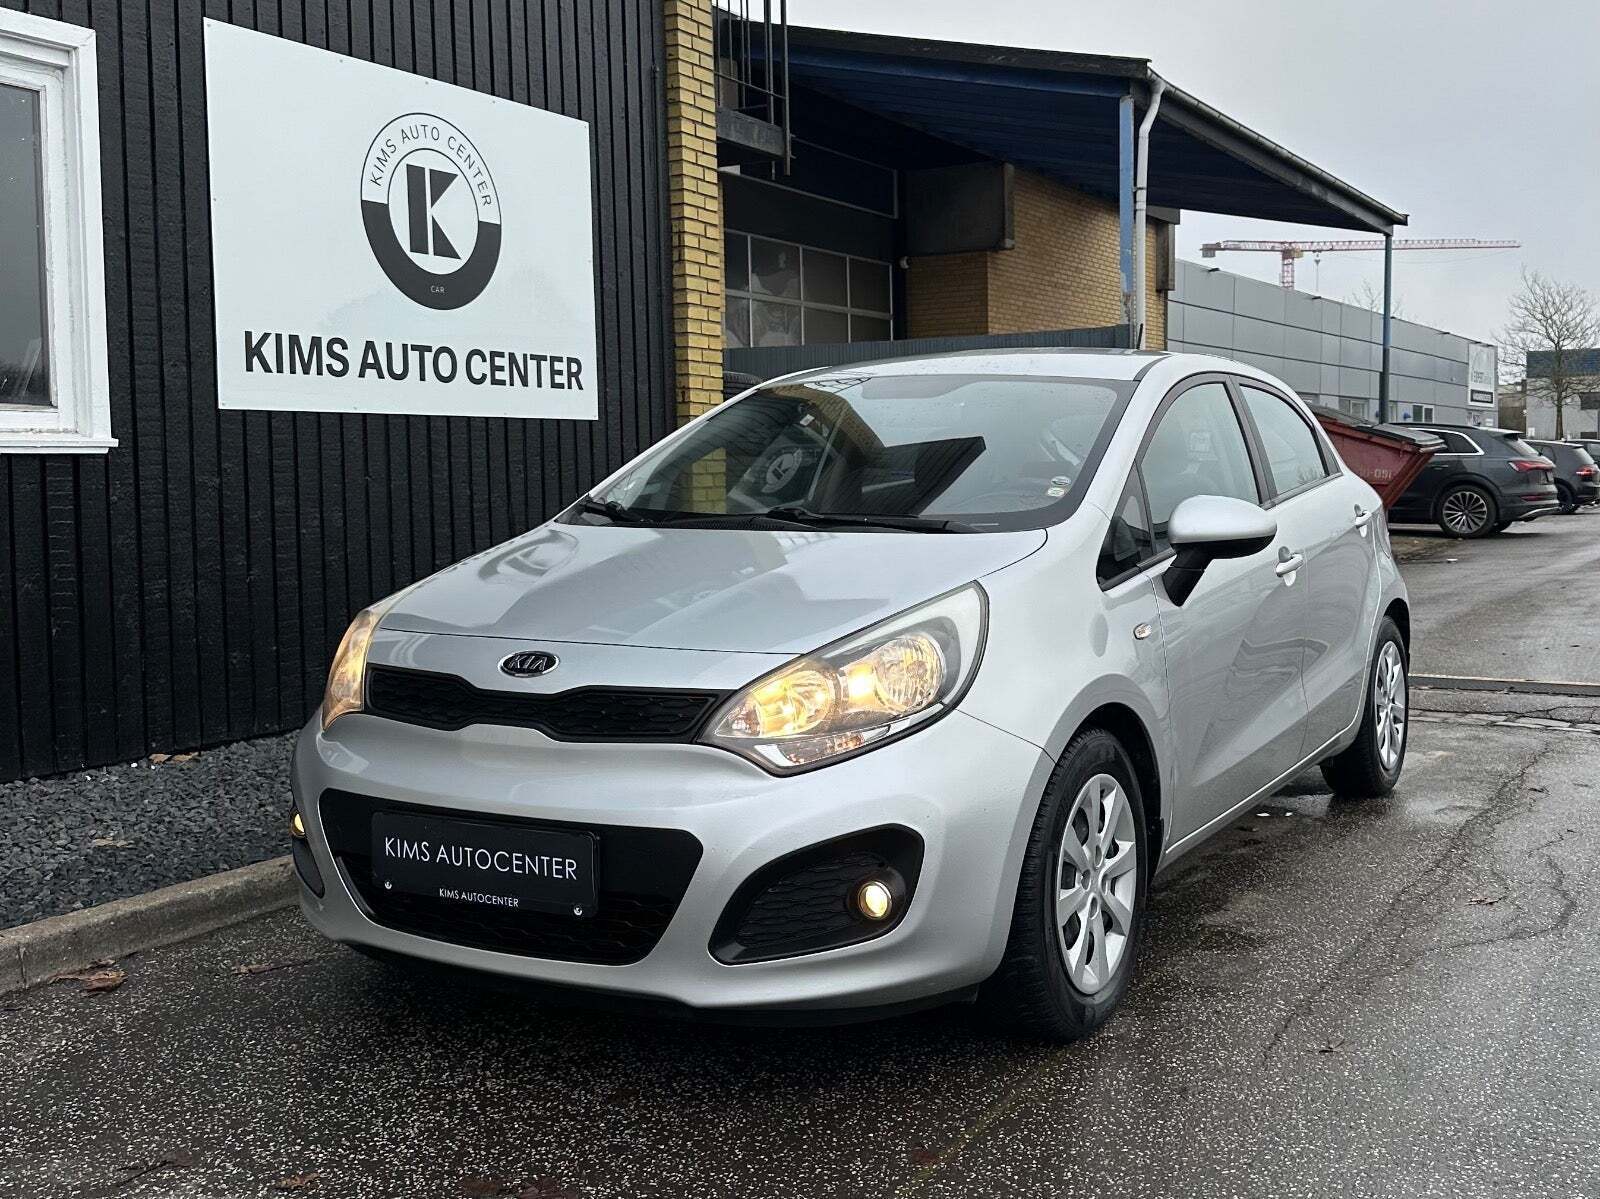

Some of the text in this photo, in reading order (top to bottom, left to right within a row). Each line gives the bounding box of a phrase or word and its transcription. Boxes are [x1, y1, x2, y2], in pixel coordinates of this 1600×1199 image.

[370, 124, 492, 207] KIMS AUTO CENTER
[430, 285, 445, 294] CAR
[244, 330, 584, 391] KIMS AUTO CENTER
[507, 654, 548, 671] KIA
[385, 836, 577, 880] KIMS AUTOCENTER
[439, 887, 519, 908] KIMS AUTOCENTER
